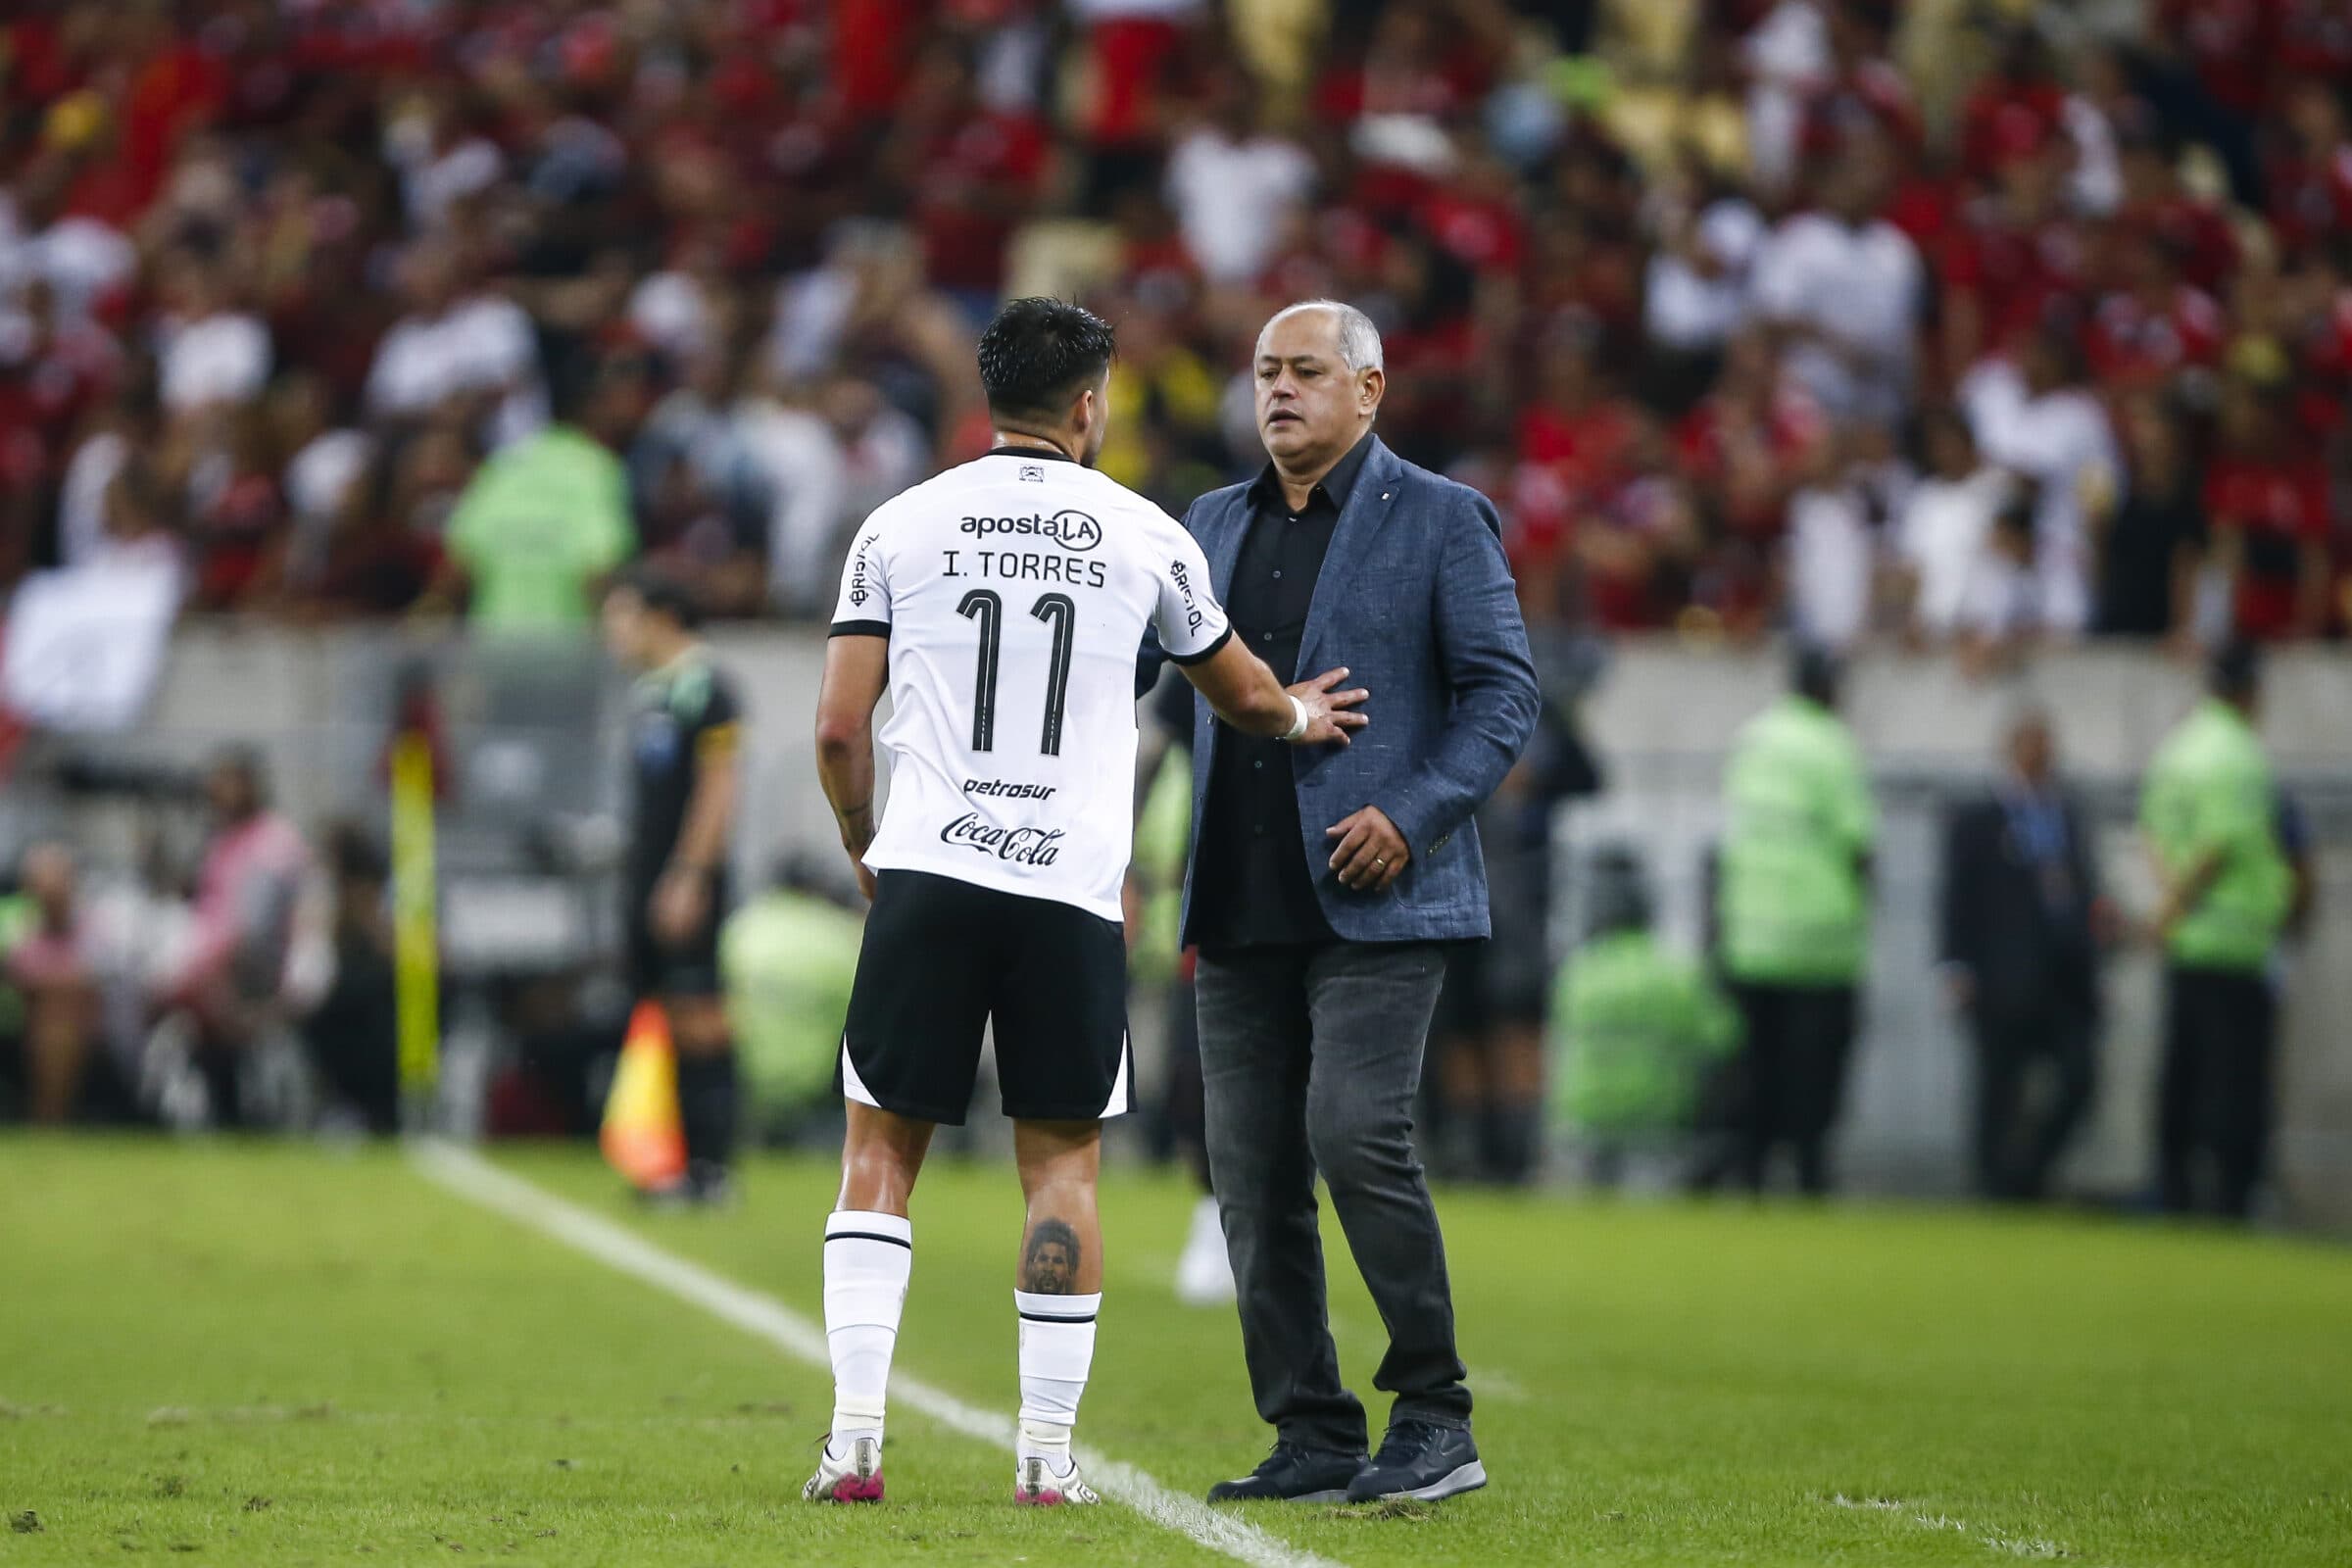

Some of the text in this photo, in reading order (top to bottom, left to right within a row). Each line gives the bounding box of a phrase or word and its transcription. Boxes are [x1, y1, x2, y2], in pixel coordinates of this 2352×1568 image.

[943, 551, 1106, 588] I. TORRES
[1170, 560, 1202, 637] BRISTOL
[956, 588, 1075, 756] 11
[963, 778, 1055, 801] petrosur
